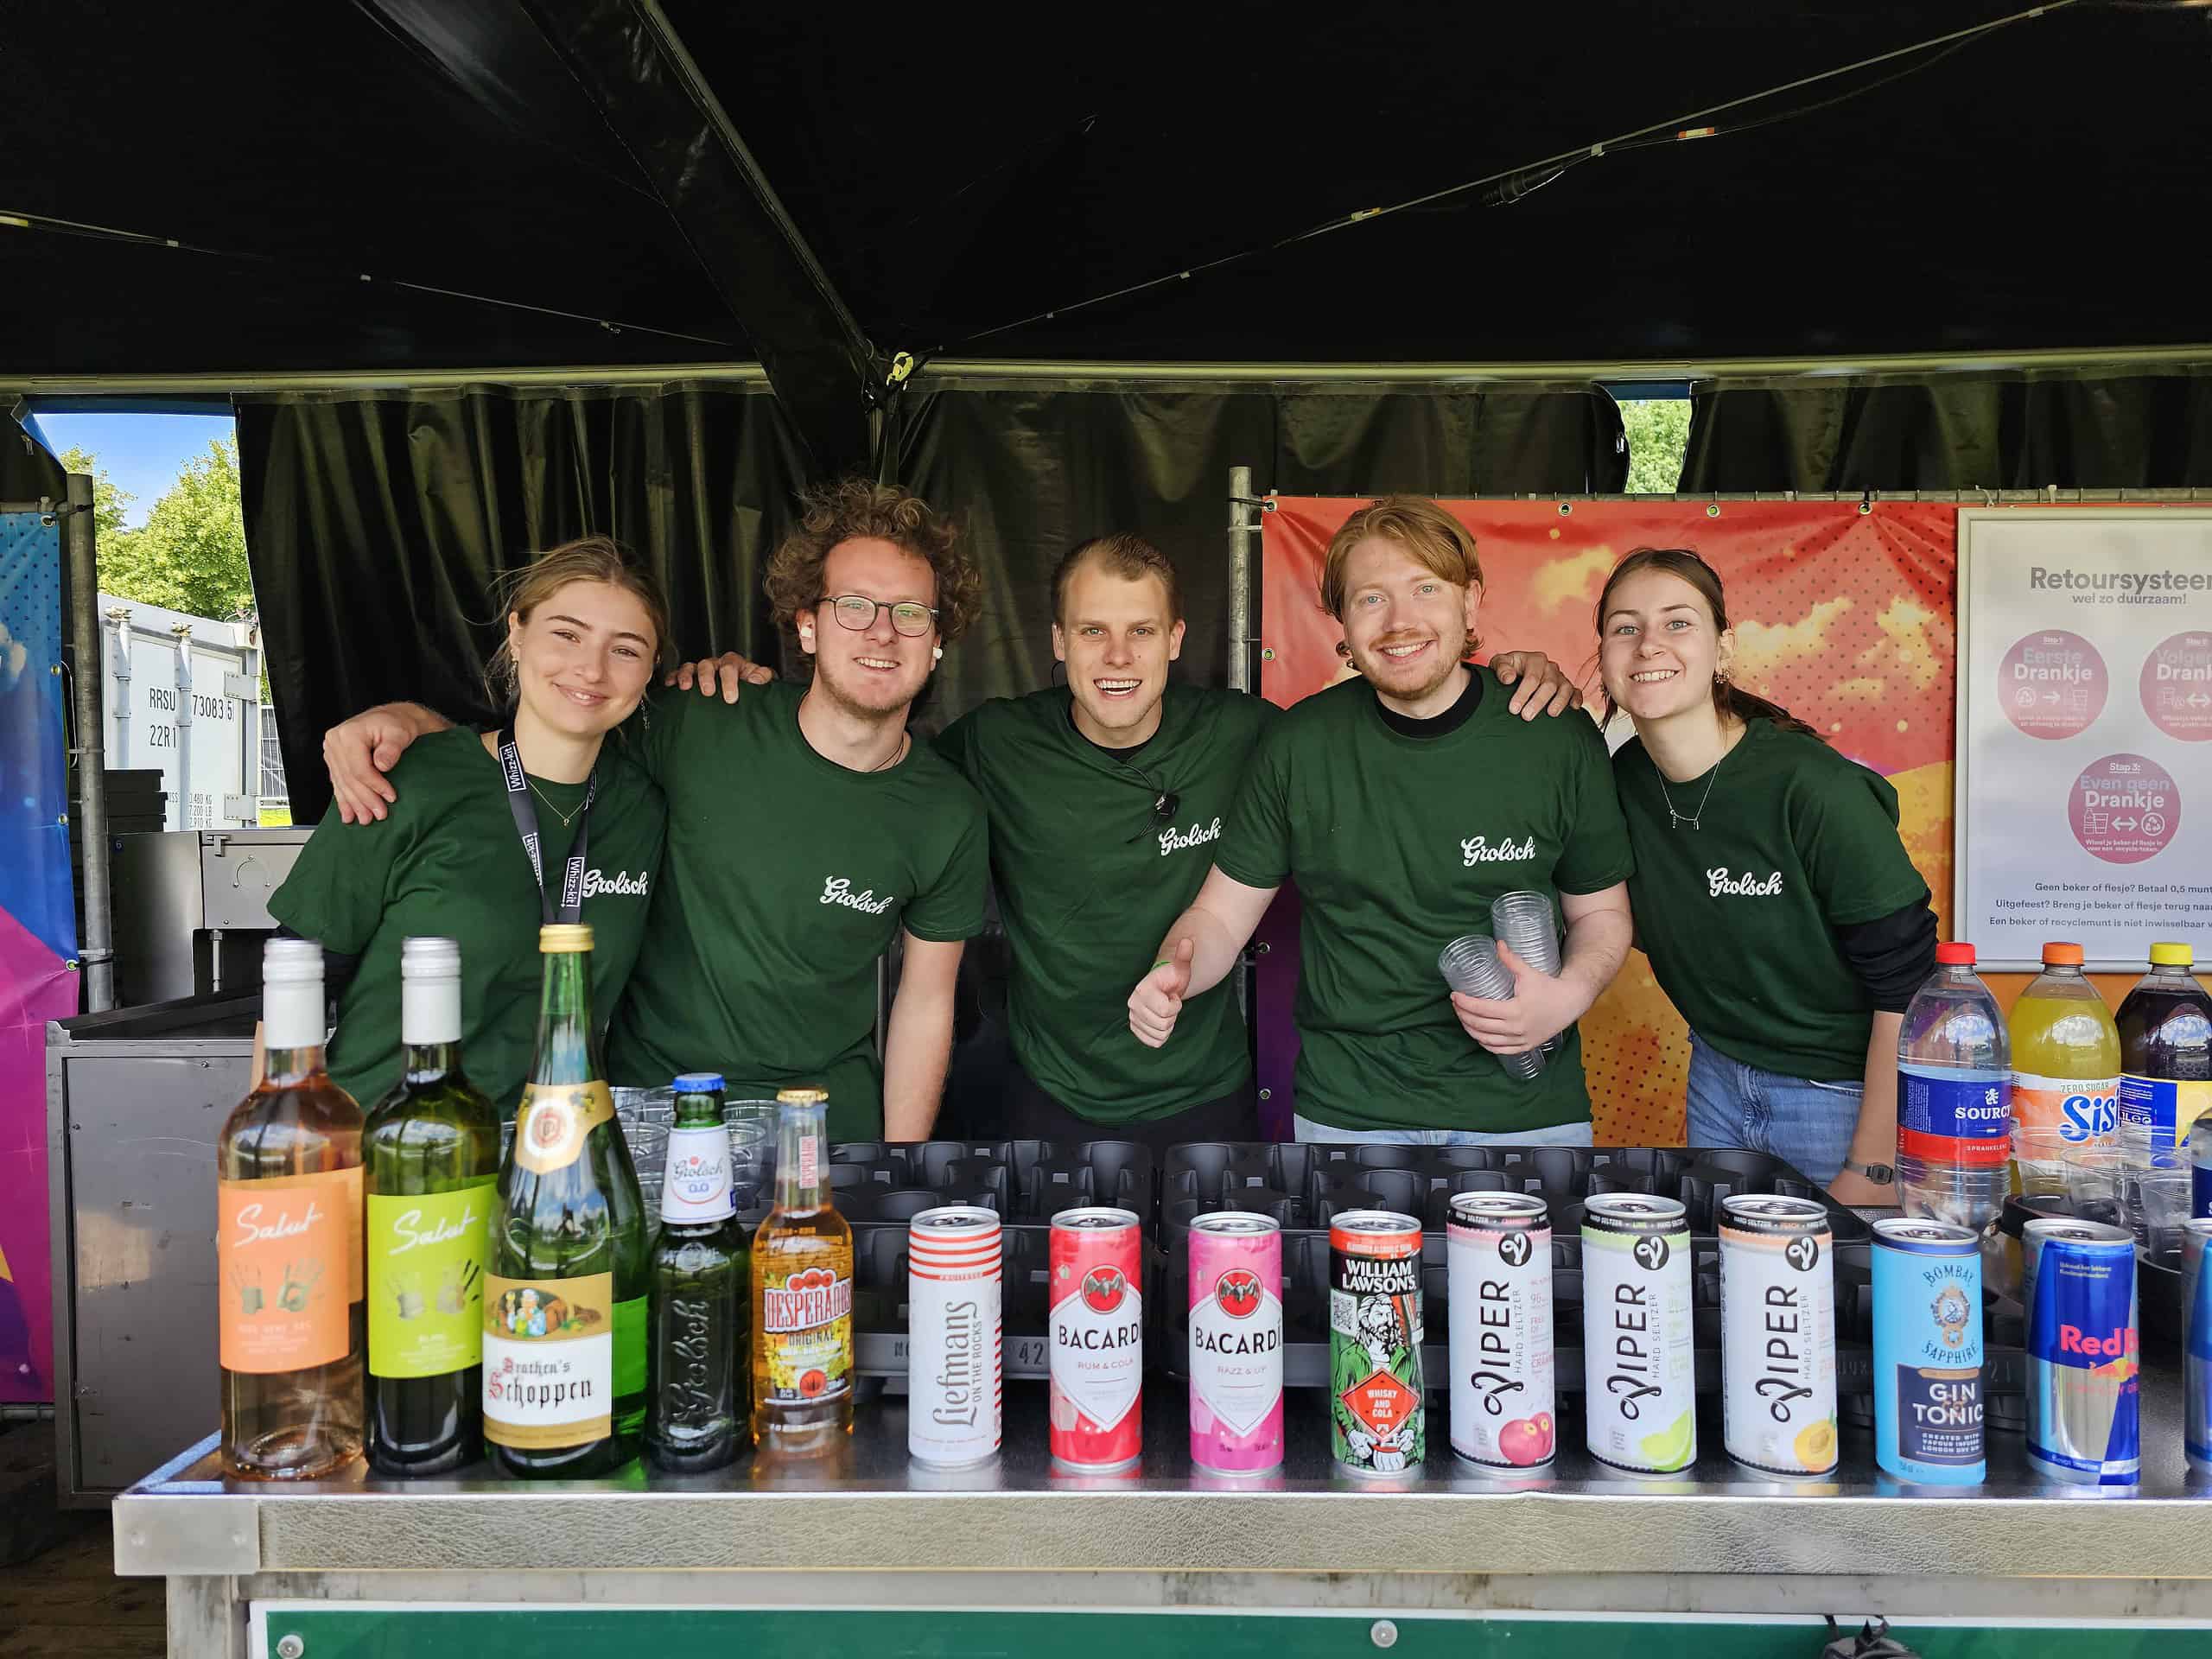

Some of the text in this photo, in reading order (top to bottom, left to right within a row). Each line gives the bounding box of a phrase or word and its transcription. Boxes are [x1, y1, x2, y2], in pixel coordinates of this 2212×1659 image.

[2073, 594, 2187, 605] wel zo duurzaam!
[2023, 649, 2083, 664] Eerste
[2014, 664, 2093, 684] Drankje
[149, 688, 176, 711] RRSU
[149, 724, 177, 748] 22R1
[2109, 762, 2131, 772] Stap
[2080, 775, 2171, 792] Even geen
[2085, 791, 2164, 811] Drankje
[1158, 817, 1222, 856] Grolsch
[1460, 836, 1536, 867] Grolsch
[566, 860, 582, 904] Whizz-kit
[582, 868, 648, 898] Grolsch
[1707, 867, 1783, 898] Grolsch
[2035, 882, 2060, 892] Geen
[2063, 882, 2090, 892] beker
[2093, 883, 2102, 892] of
[2105, 884, 2135, 894] flesje?
[2139, 884, 2168, 893] Betaal
[819, 875, 894, 916] Grolsch
[1996, 899, 2050, 910] Uitgefeest?
[2052, 900, 2081, 911] Breng
[2083, 901, 2092, 911] je
[2094, 900, 2121, 910] beker
[2124, 901, 2133, 910] of
[2137, 901, 2162, 912] flesje
[2164, 903, 2190, 912] terug
[1990, 916, 2006, 925] Een
[2009, 917, 2036, 925] beker
[2051, 918, 2111, 927] recyclemunt
[2113, 918, 2121, 927] is
[2124, 918, 2142, 927] niet
[2145, 918, 2205, 928] inwisselbaar
[2060, 1081, 2109, 1094] ZERO SUGAR
[2059, 1095, 2117, 1141] Sis
[673, 1156, 724, 1180] Grolsch
[235, 1202, 324, 1247] Salut
[390, 1205, 477, 1255] Salut
[1345, 1258, 1412, 1278] WILLIAM
[1923, 1264, 1975, 1287] BOMBAY
[973, 1320, 982, 1403] ON THE ROCKS
[1922, 1339, 1979, 1364] SAPPHIRE
[932, 1300, 977, 1427] Liefmans
[488, 1370, 593, 1408] Schoppen
[1929, 1382, 1977, 1402] GIN
[1372, 1408, 1393, 1418] COLA
[1374, 1399, 1391, 1408] AND
[1912, 1403, 1984, 1426] TONIC
